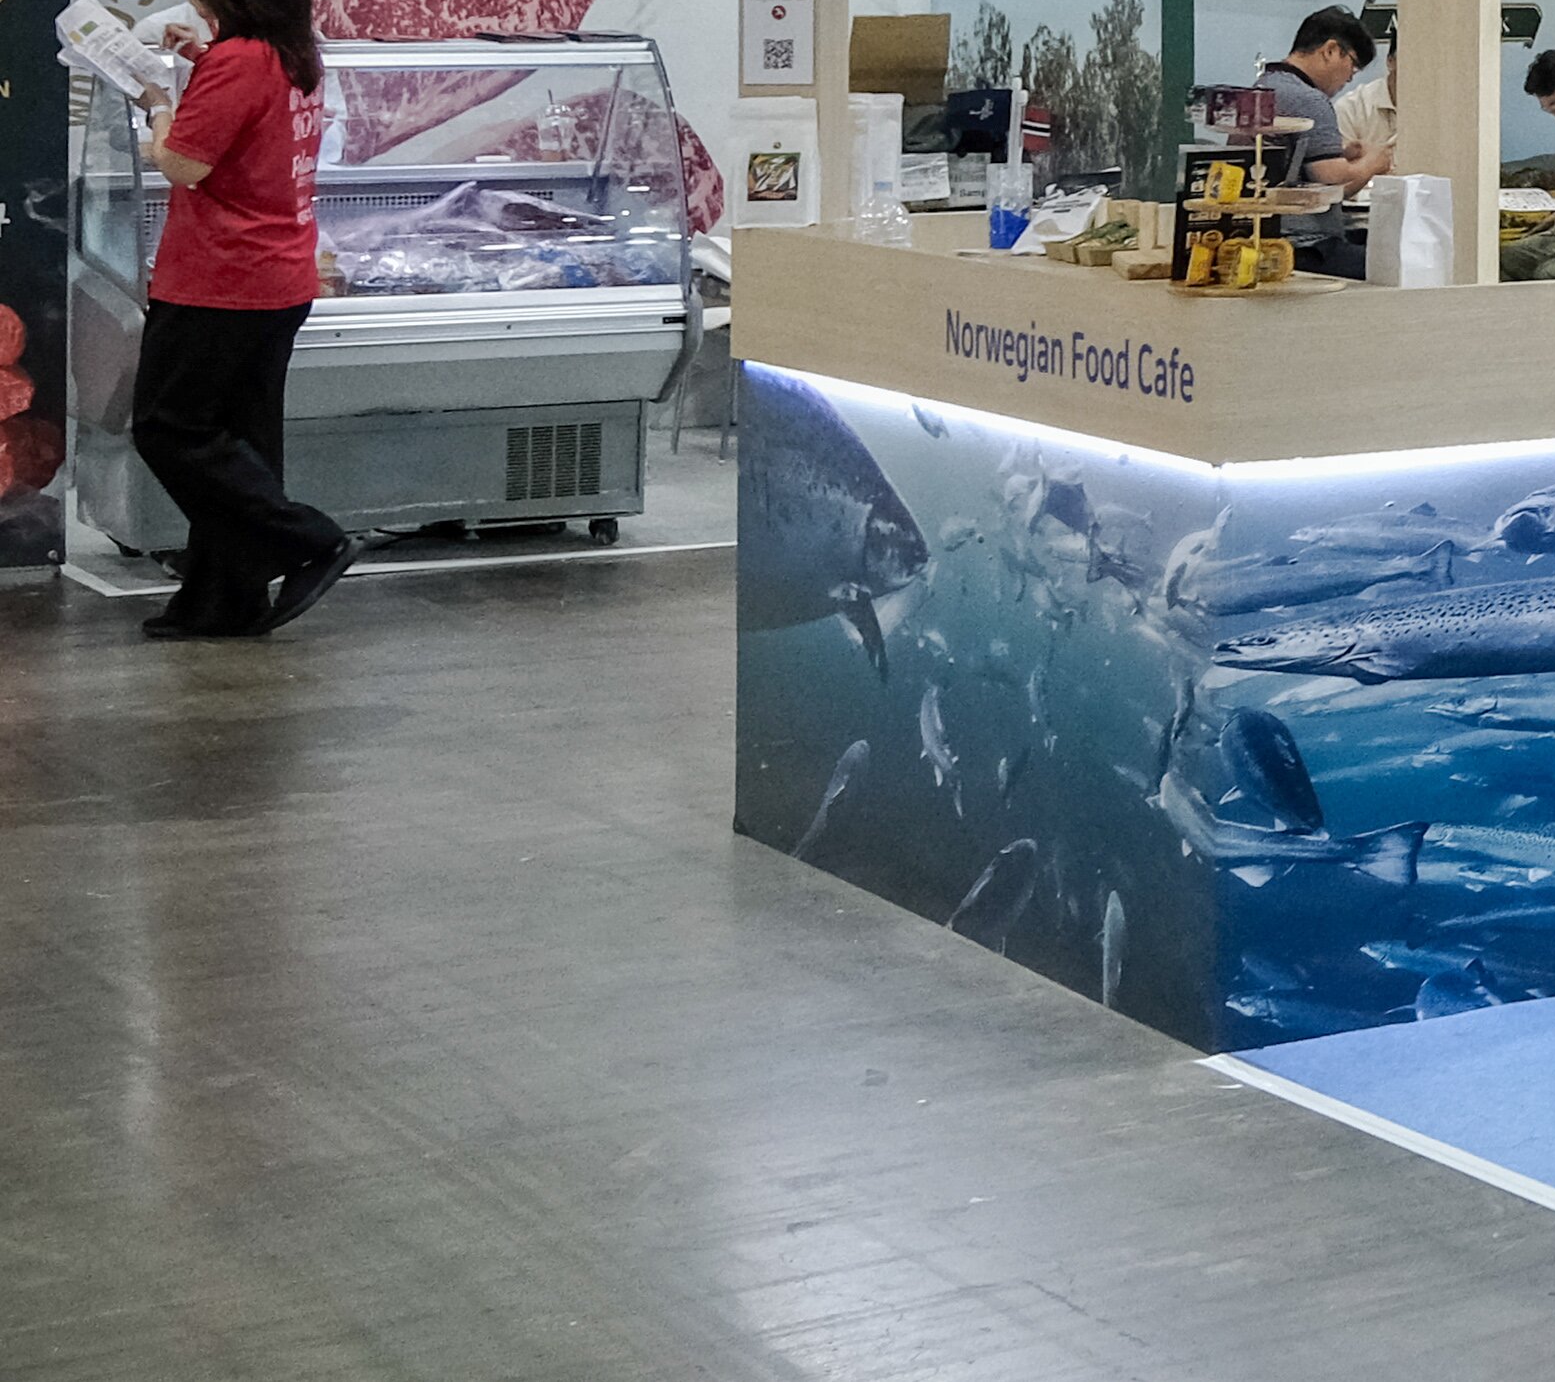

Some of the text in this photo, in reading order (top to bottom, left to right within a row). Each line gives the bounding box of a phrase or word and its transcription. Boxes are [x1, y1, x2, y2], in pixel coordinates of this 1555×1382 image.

[944, 308, 1195, 404] Norwegian Food Cafe
